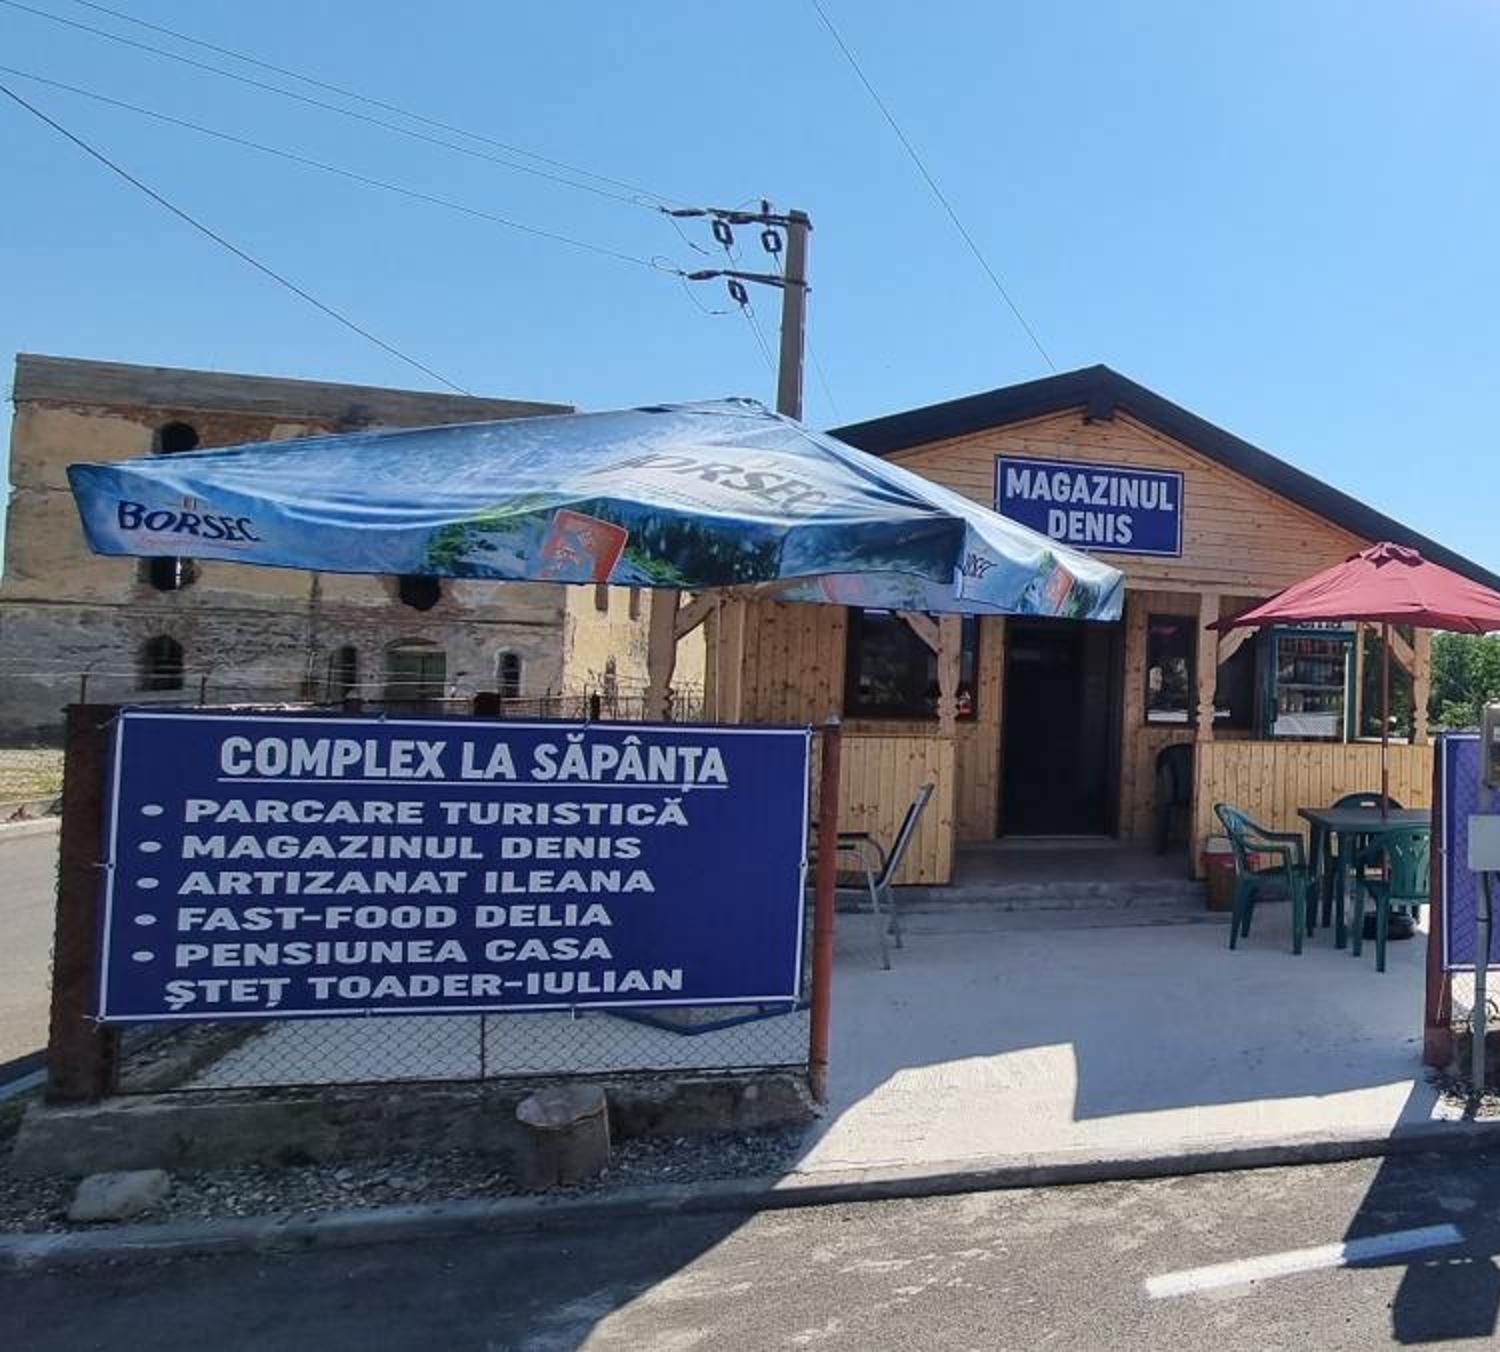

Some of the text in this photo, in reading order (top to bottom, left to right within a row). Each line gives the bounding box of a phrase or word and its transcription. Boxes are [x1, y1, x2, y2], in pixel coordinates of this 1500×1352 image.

[1005, 467, 1174, 511] MAGAZINUL
[117, 500, 261, 541] BORSEC
[1048, 509, 1133, 544] DENIS
[220, 735, 446, 779] COMPLEX
[461, 742, 517, 780] LA
[185, 798, 689, 826] PARCARE TURISTICĂ
[181, 835, 642, 860] MAGAZINUL DENIS
[177, 869, 656, 895] ARTIZANAT ILEANA
[177, 903, 613, 931] FAST-FOOD DELIA
[175, 937, 613, 967] PENSIUNEA CASA
[307, 968, 683, 999] TOADER-IULIAN
